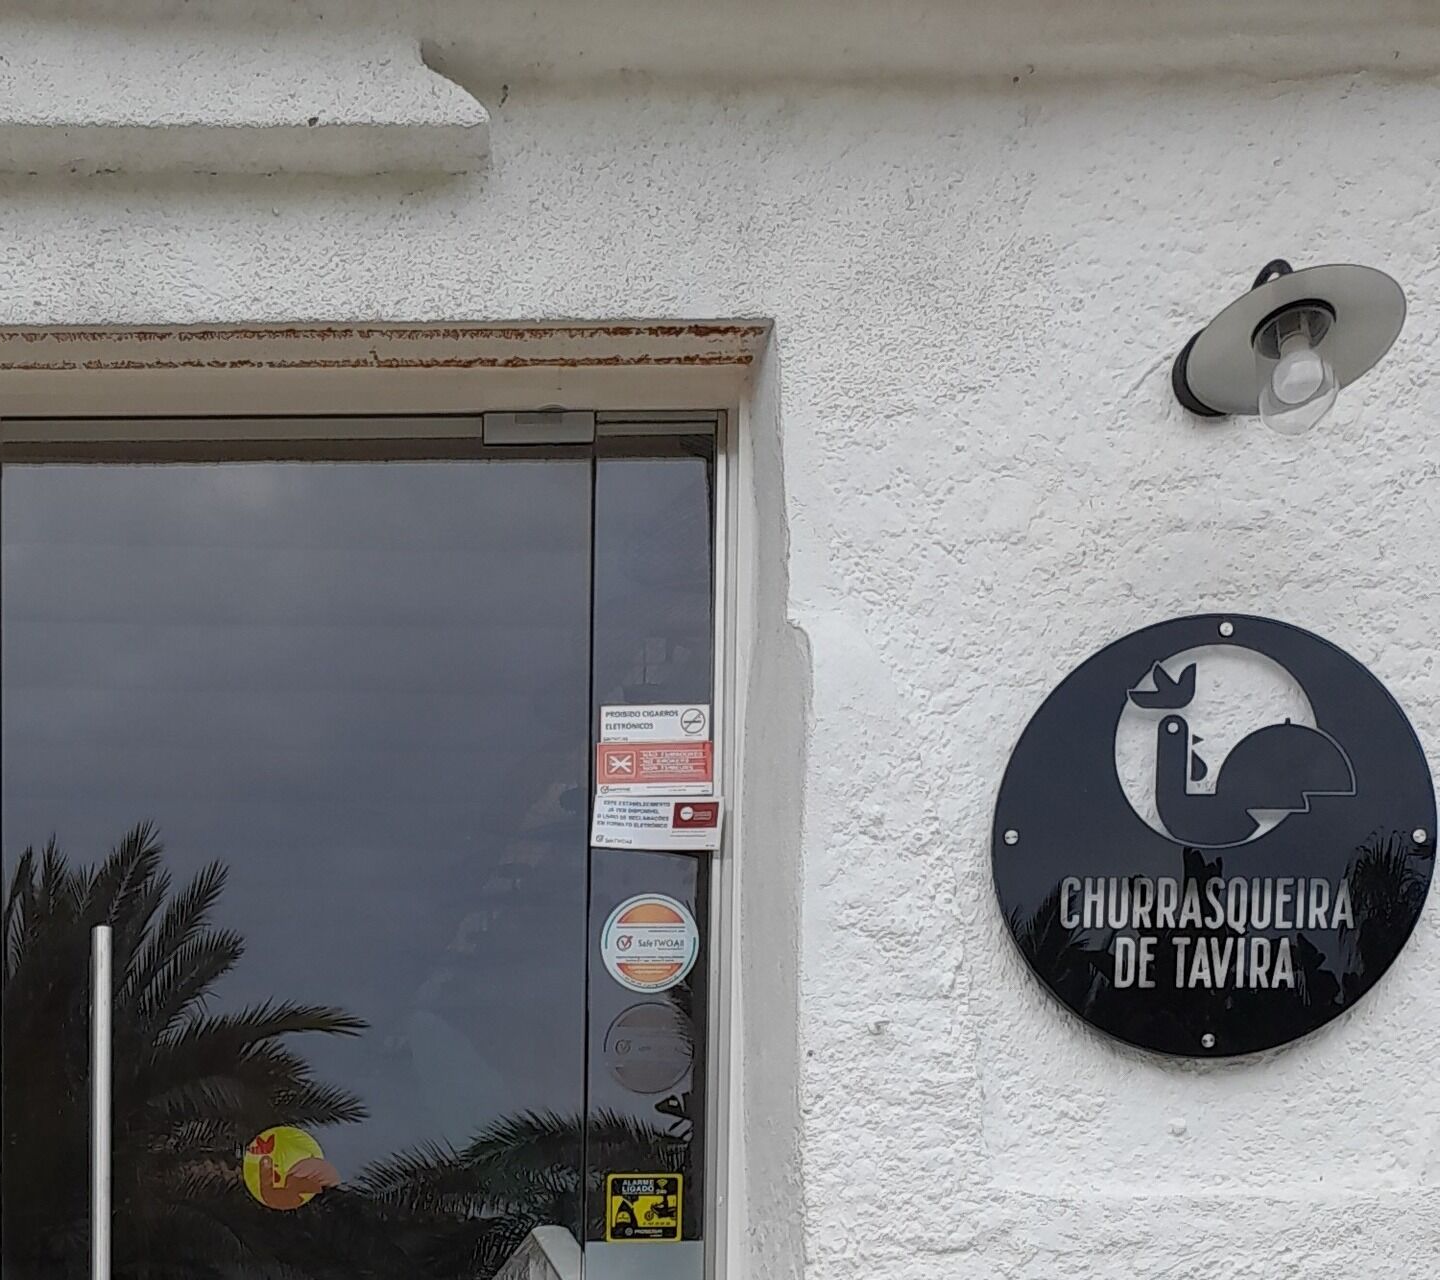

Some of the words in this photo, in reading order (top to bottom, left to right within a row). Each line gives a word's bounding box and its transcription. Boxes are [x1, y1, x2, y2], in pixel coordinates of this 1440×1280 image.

[642, 710, 679, 718] CIGARROS
[1060, 876, 1356, 934] CHURRASQUEIRA
[1114, 937, 1156, 989] DE
[1172, 936, 1296, 989] TAVIRA
